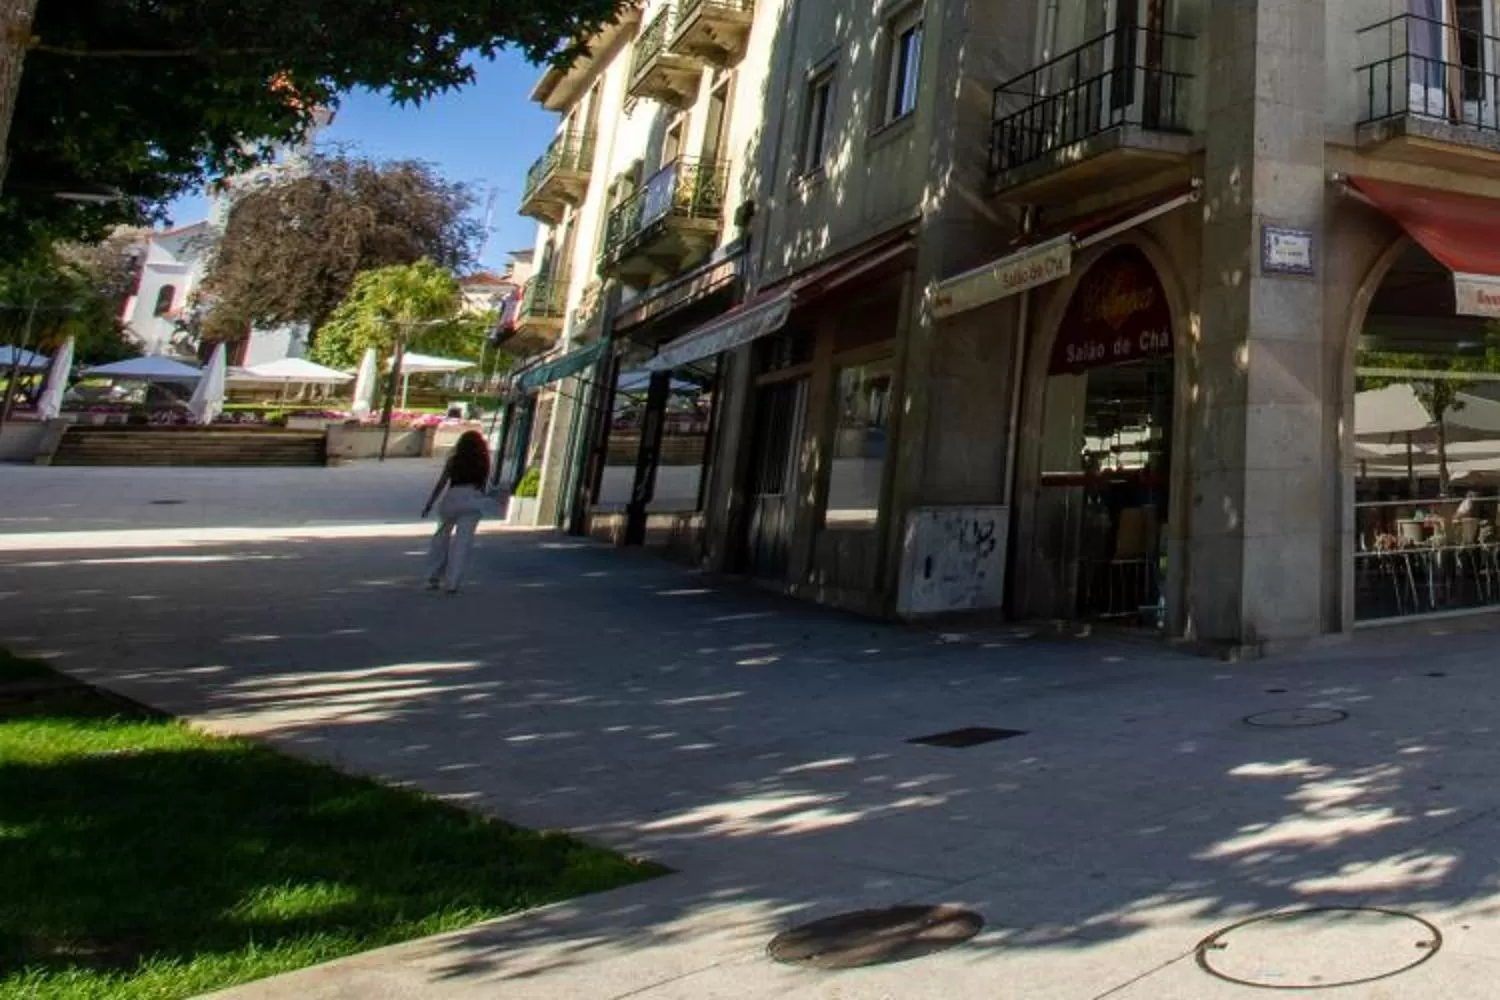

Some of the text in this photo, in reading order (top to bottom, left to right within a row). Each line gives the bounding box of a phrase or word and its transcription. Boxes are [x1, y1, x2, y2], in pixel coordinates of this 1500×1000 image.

[1066, 326, 1169, 363] Salão de Chá
